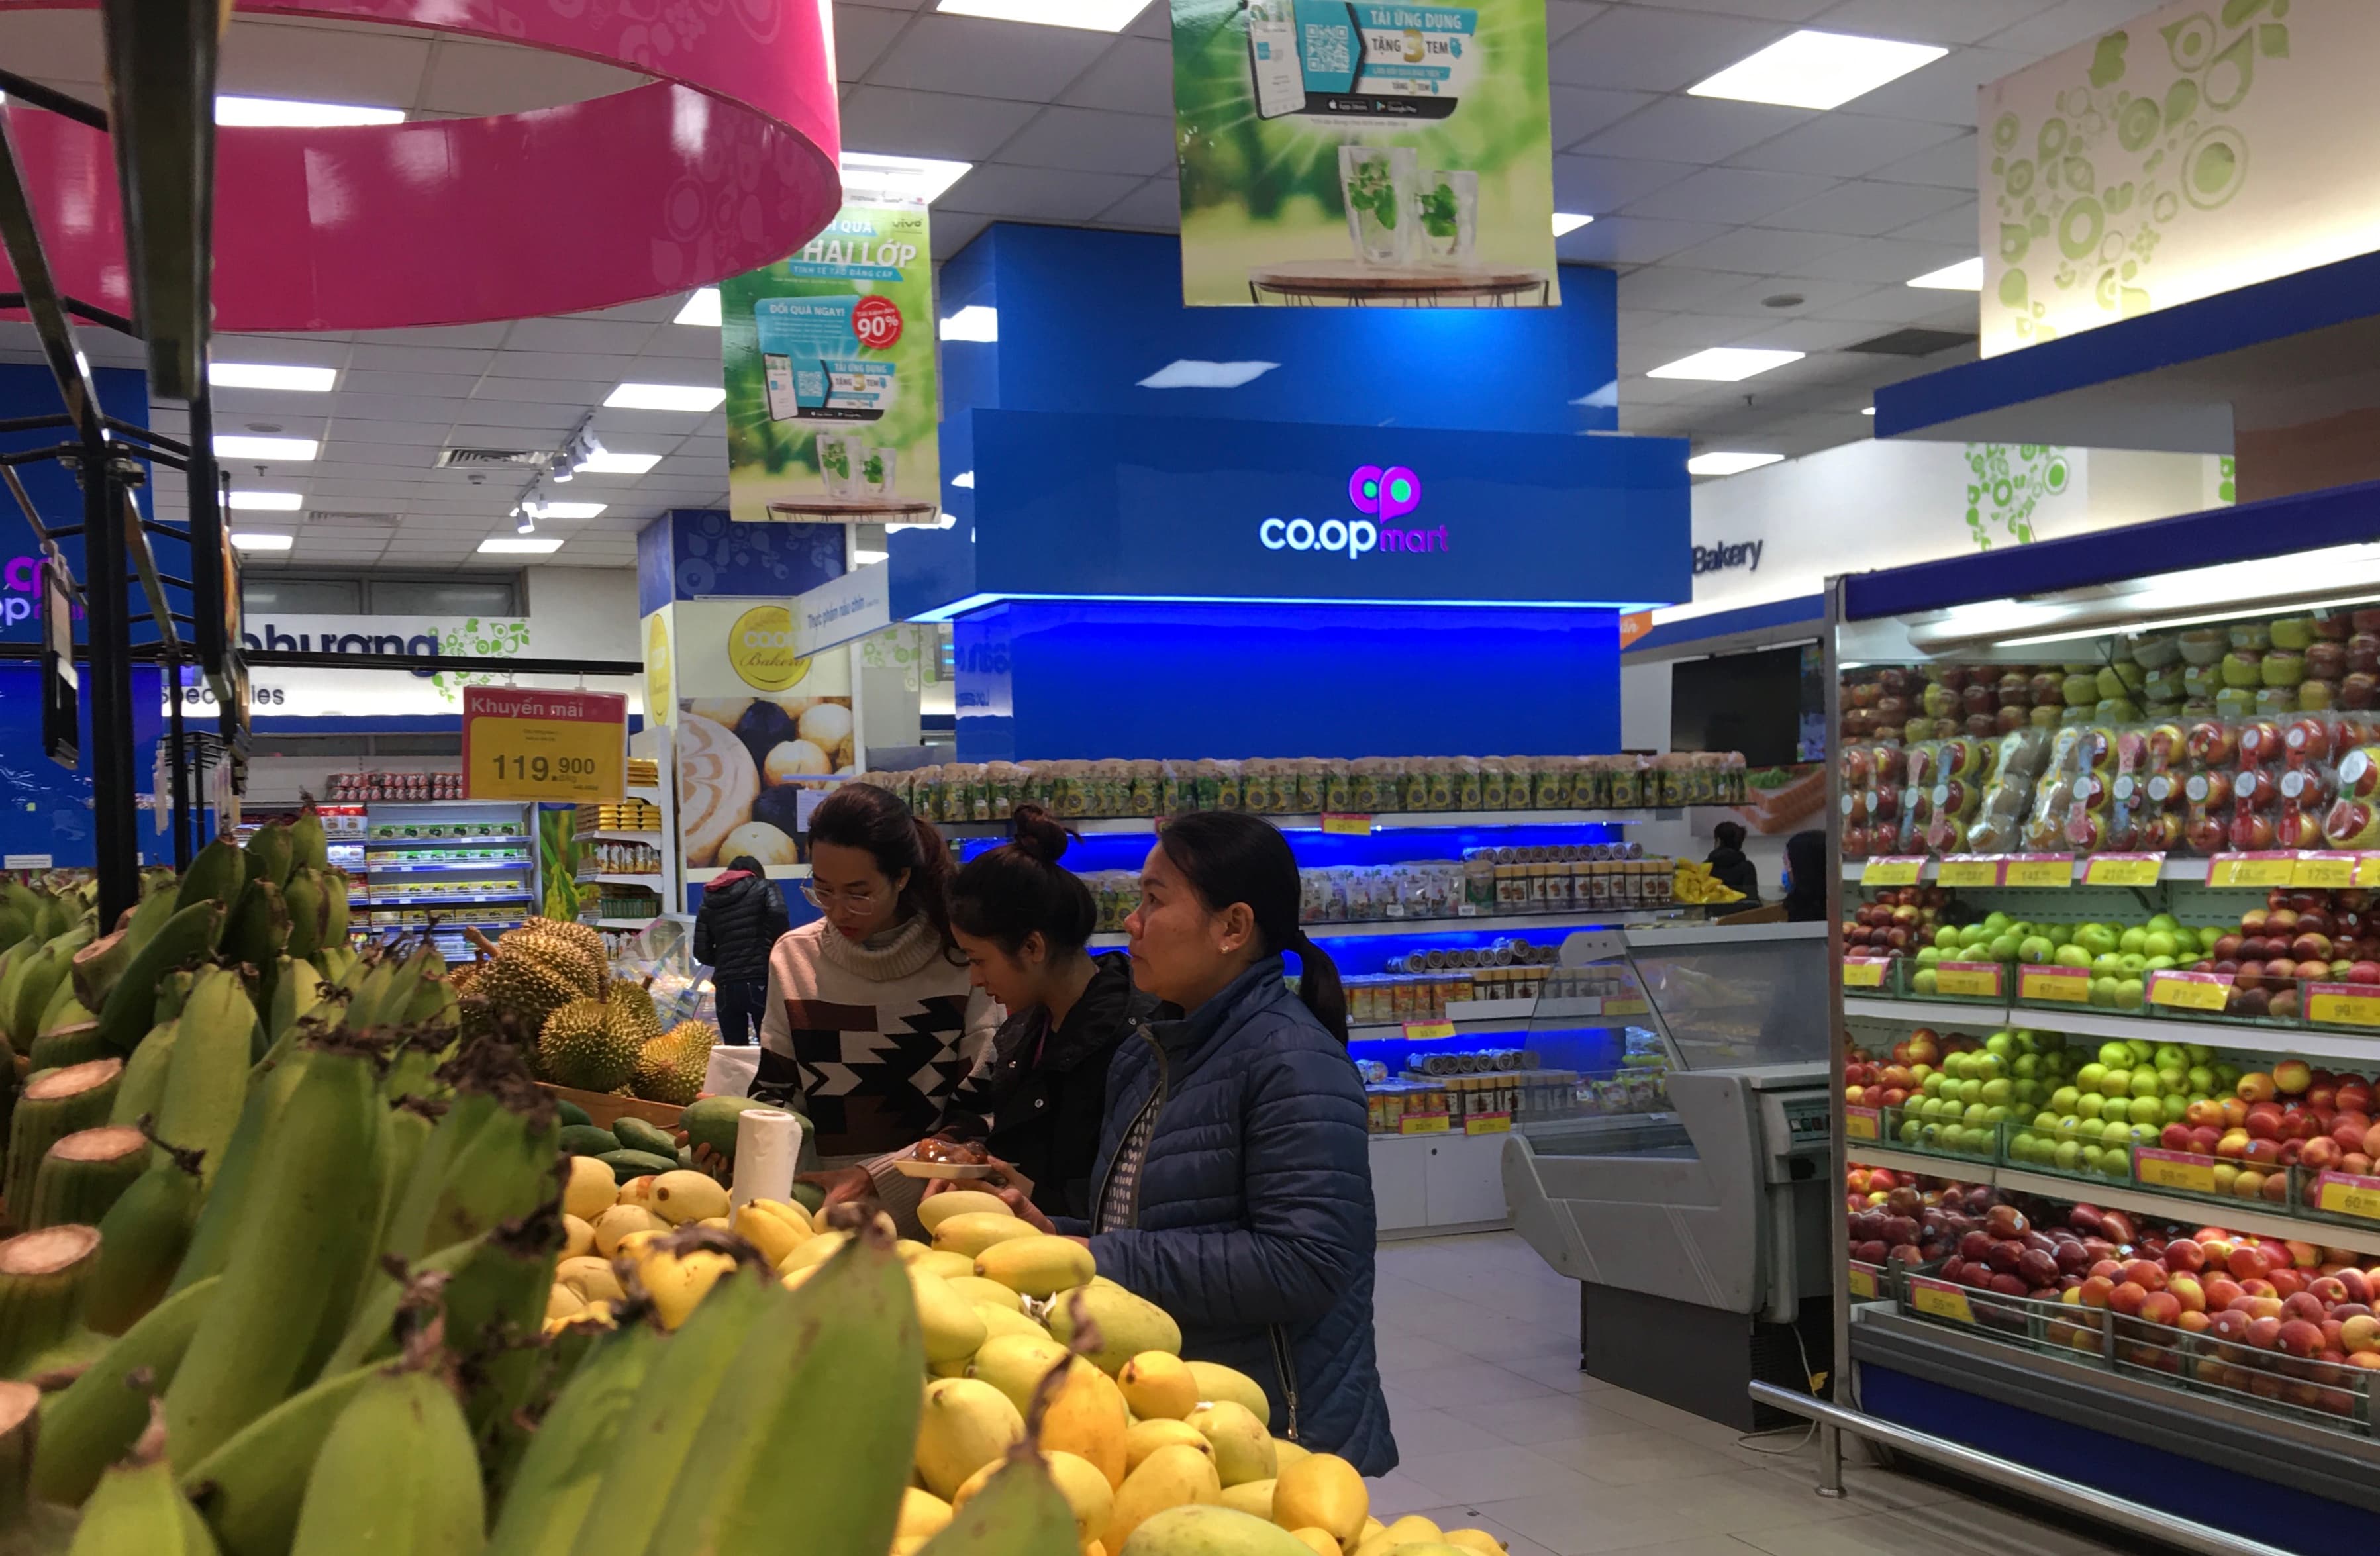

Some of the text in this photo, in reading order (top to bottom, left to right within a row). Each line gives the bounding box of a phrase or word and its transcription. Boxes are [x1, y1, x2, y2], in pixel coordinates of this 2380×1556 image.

[1403, 28, 1424, 63] 3
[1426, 40, 1448, 54] TEM
[892, 219, 922, 228] vivo
[803, 238, 917, 268] HAI LỚP
[1692, 539, 1763, 575] Bakery
[471, 697, 583, 718] Khuyến mãi
